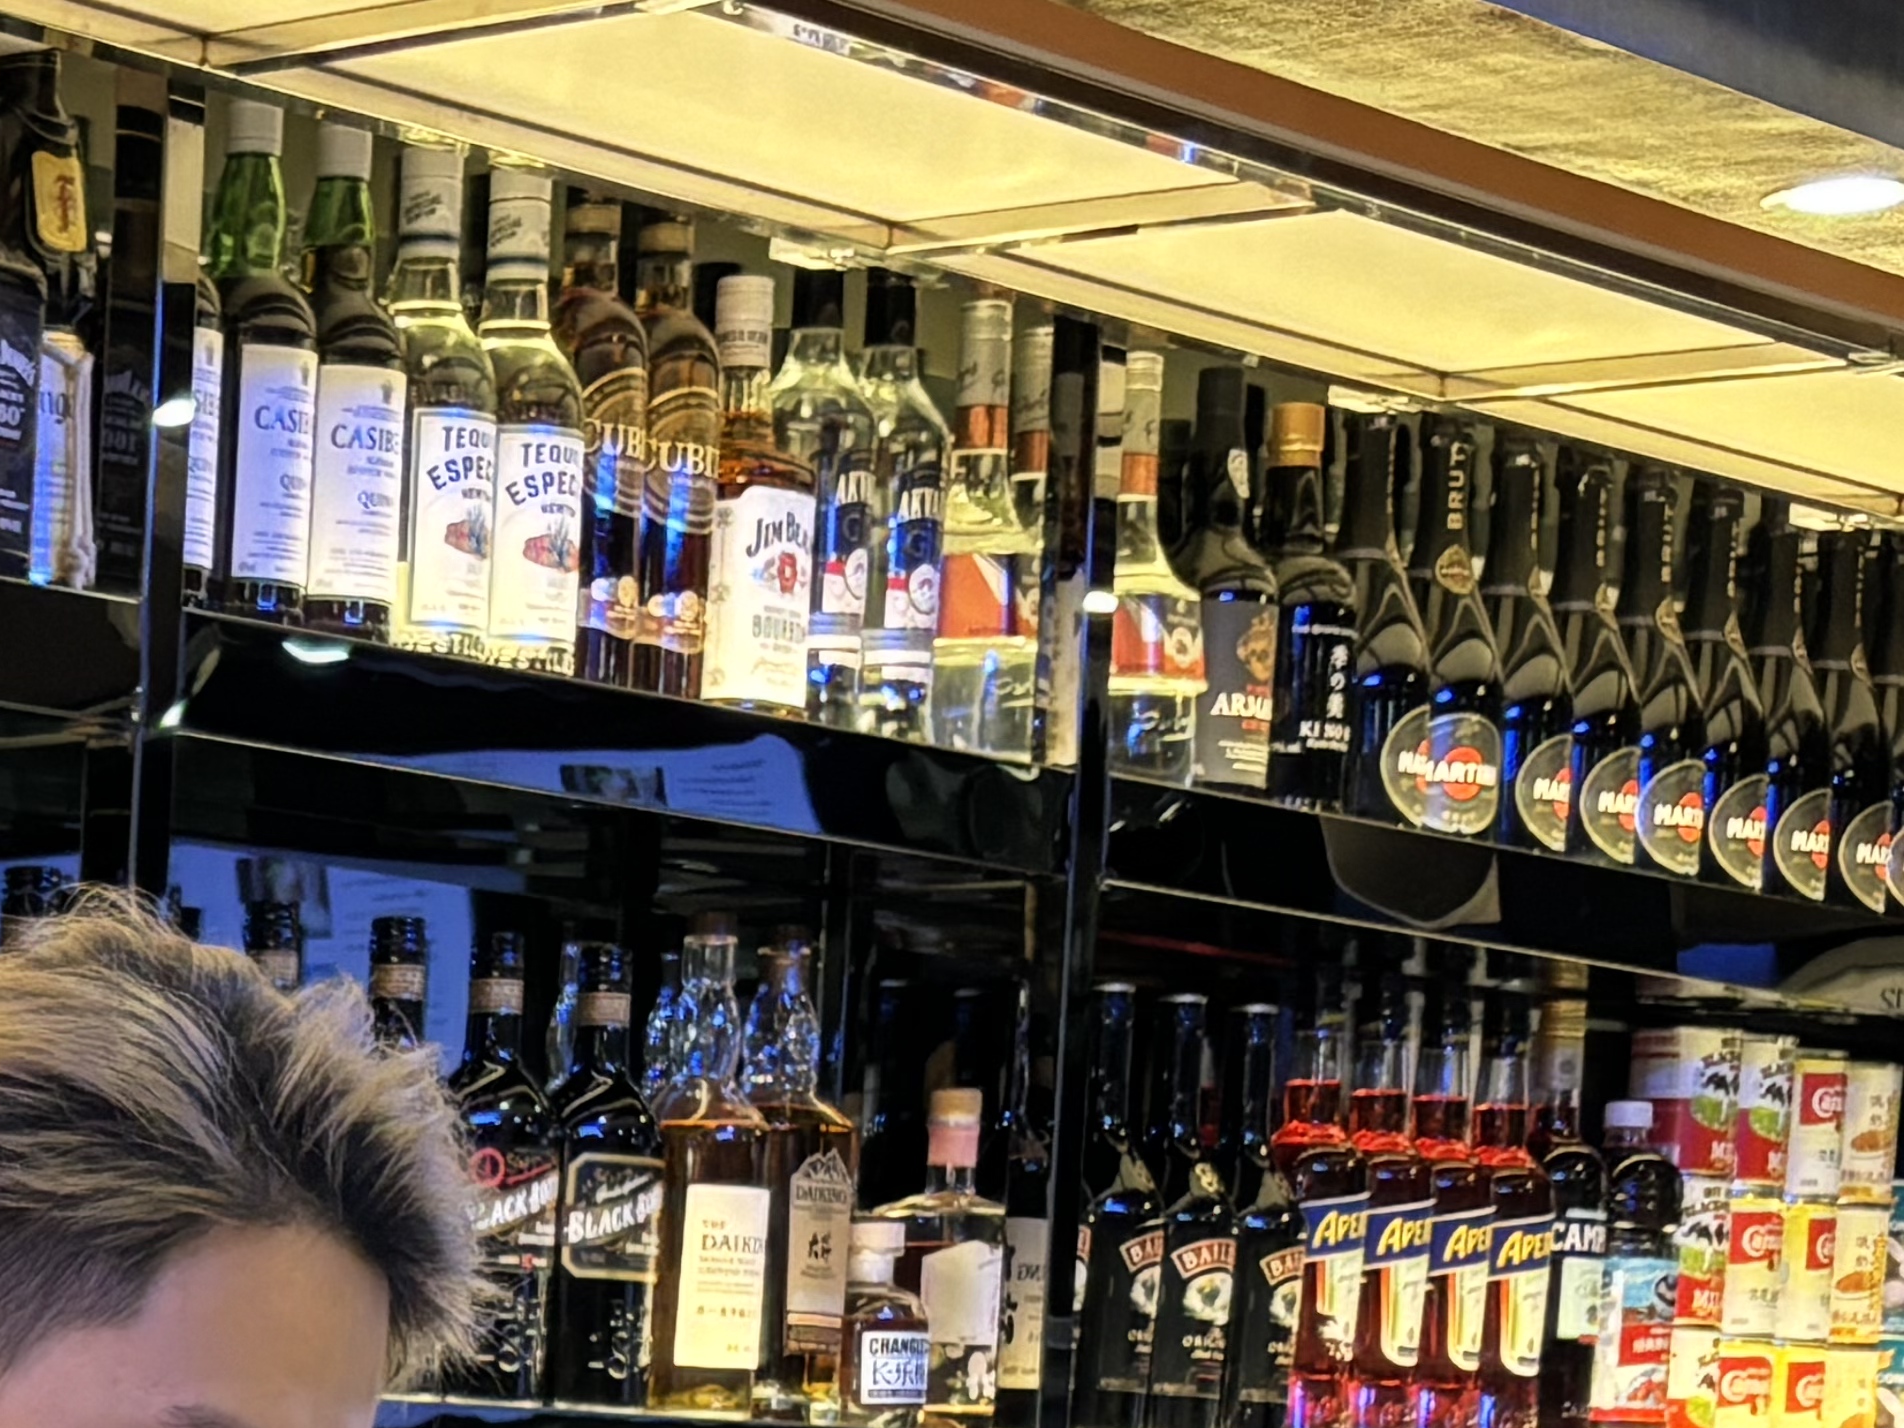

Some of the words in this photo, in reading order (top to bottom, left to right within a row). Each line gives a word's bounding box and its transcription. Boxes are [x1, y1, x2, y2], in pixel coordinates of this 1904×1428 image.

[1446, 443, 1468, 530] BRUT
[746, 516, 784, 558] JIM
[565, 1202, 634, 1246] BLACK
